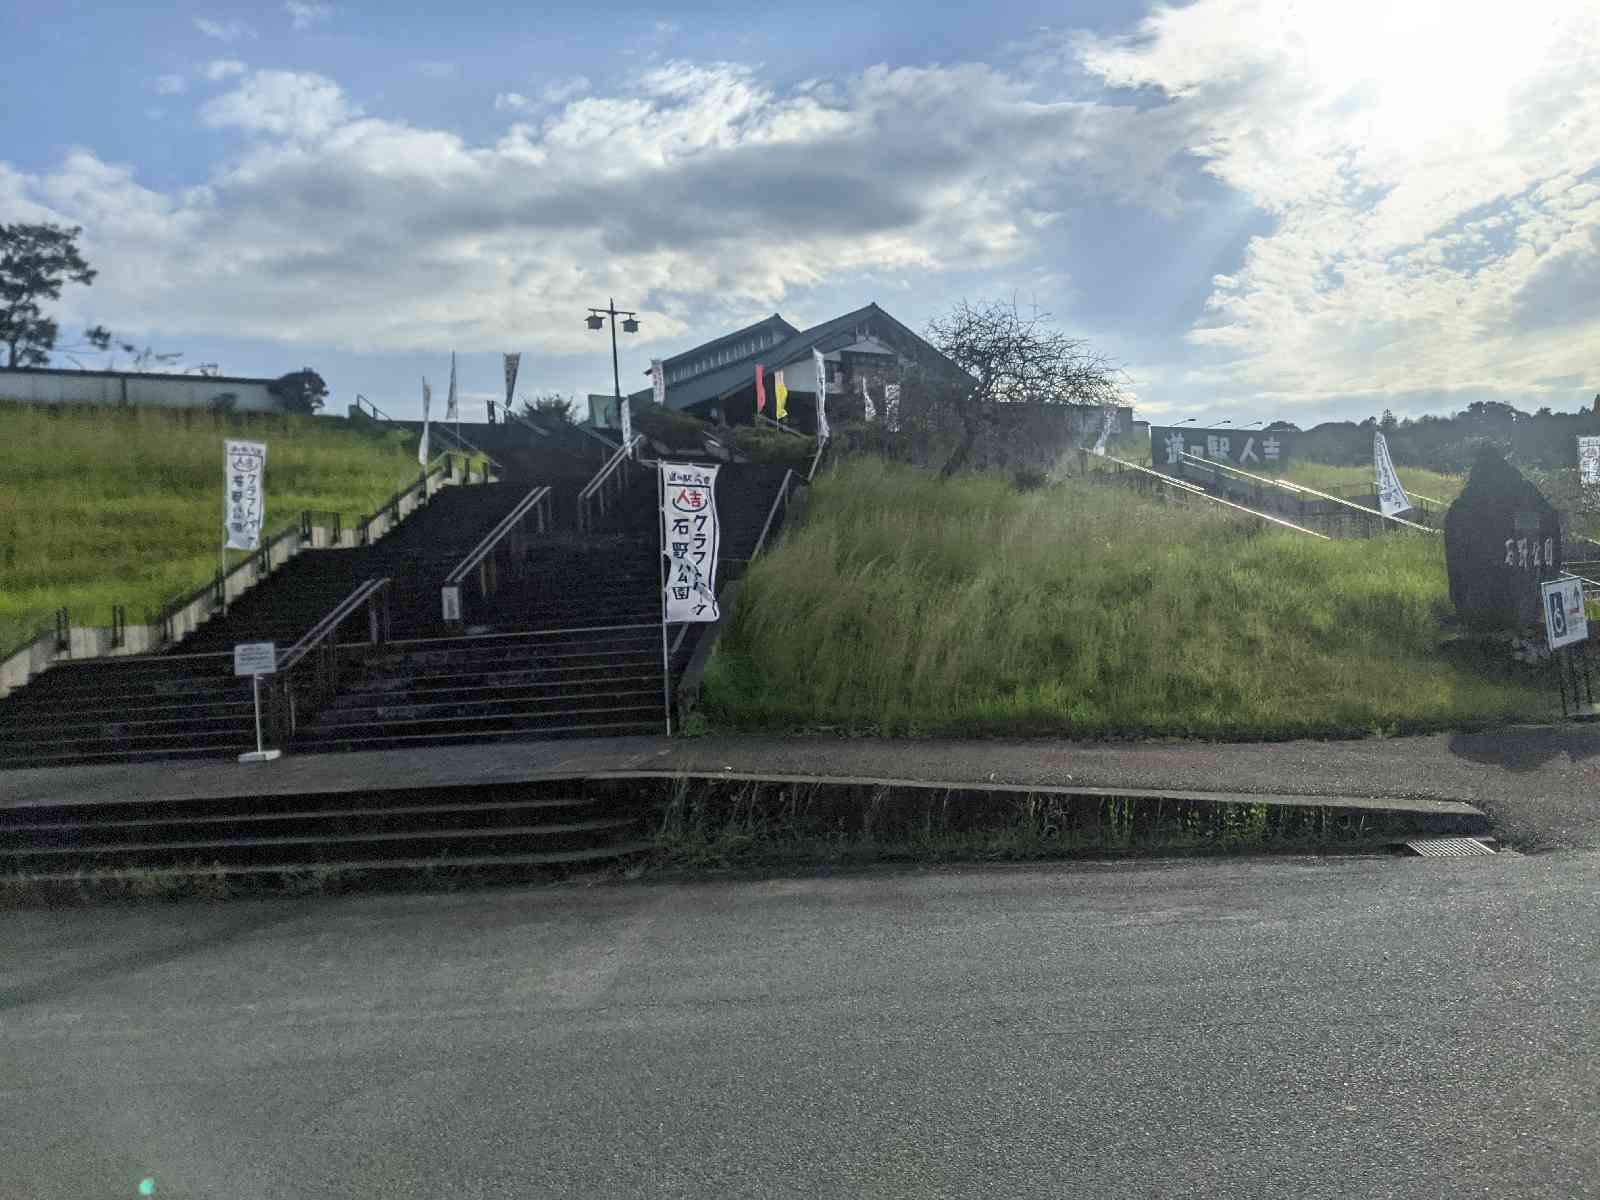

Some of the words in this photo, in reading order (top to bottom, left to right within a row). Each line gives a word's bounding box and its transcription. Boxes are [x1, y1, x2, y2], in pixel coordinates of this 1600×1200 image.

[676, 488, 704, 508] 人吉
[672, 518, 690, 600] 石野公園
